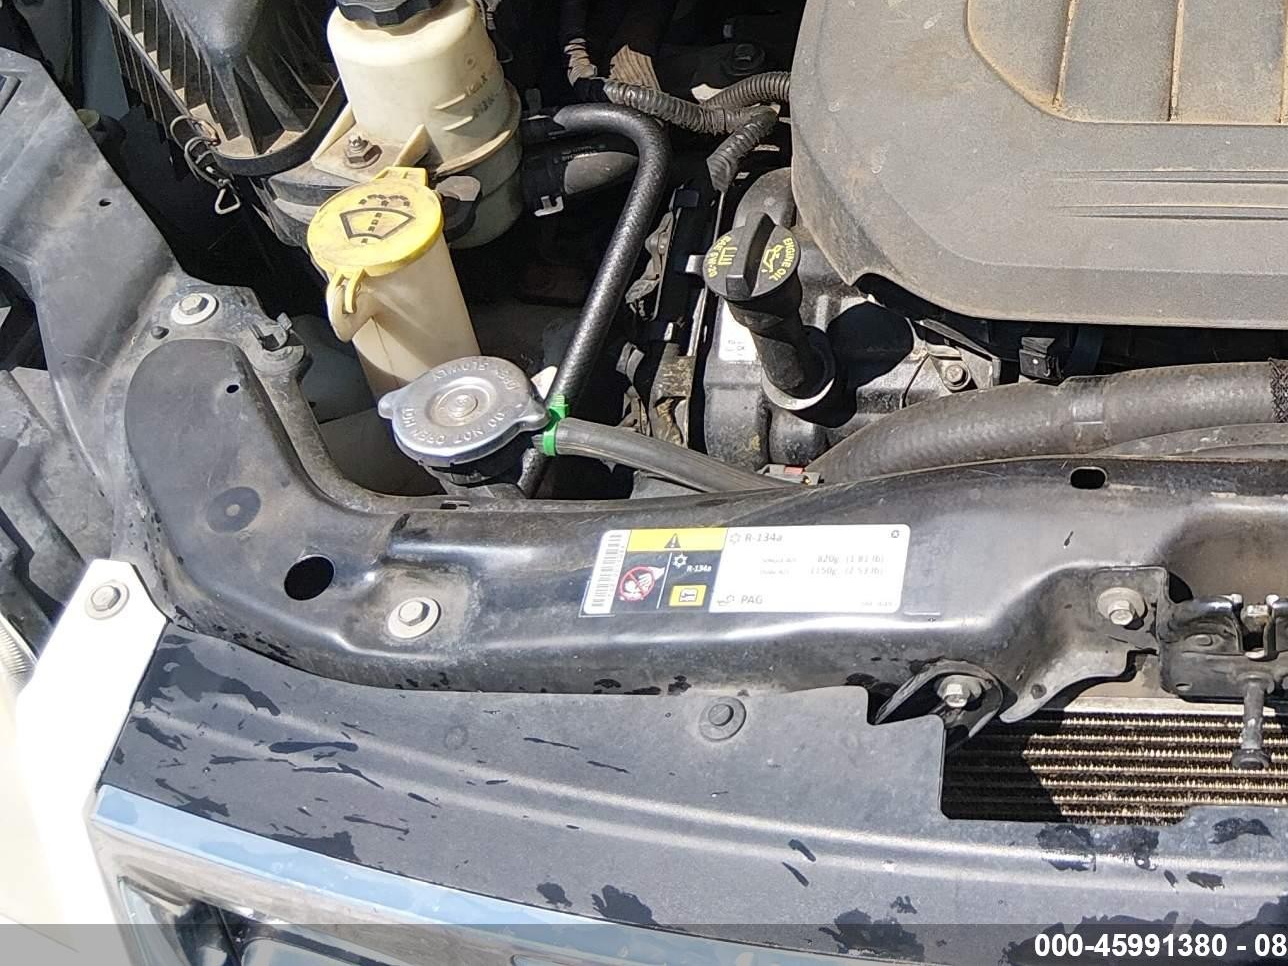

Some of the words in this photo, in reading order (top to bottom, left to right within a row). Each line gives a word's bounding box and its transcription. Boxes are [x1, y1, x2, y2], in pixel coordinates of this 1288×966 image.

[713, 235, 733, 253] SAE
[782, 237, 796, 269] ENGINE
[706, 251, 719, 278] 5W-20
[768, 268, 787, 282] OIL
[401, 407, 417, 428] HOT
[487, 412, 506, 428] DO
[413, 428, 448, 446] OPEN
[453, 427, 485, 445] NOT
[744, 533, 783, 544] R-134a
[686, 564, 713, 574] R-134a
[740, 594, 764, 605] PAG
